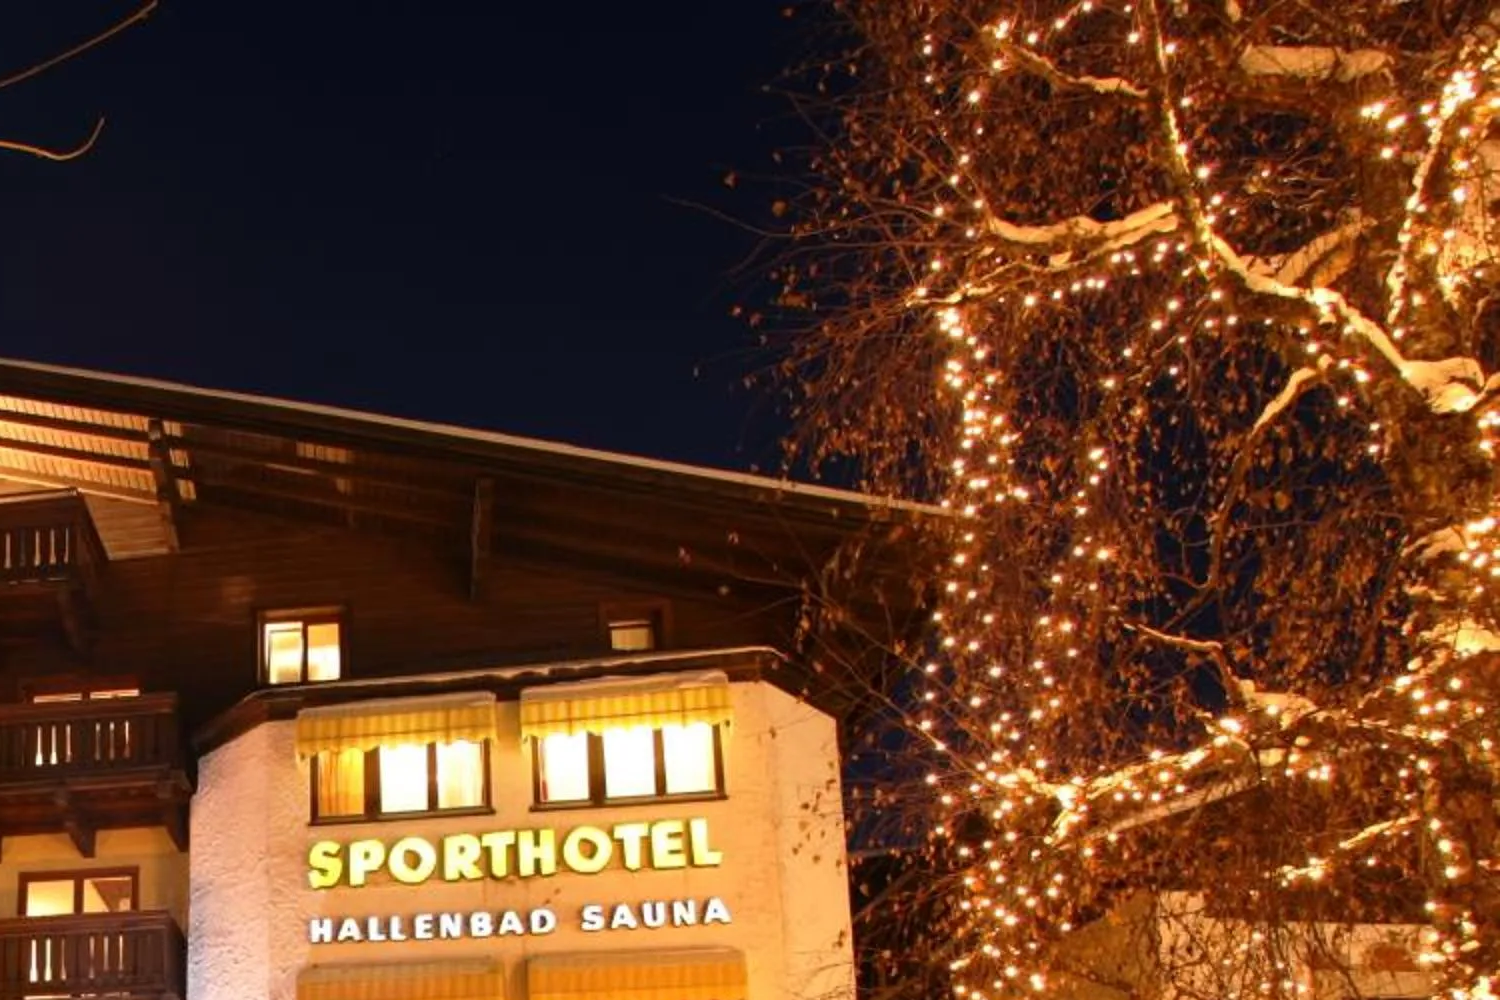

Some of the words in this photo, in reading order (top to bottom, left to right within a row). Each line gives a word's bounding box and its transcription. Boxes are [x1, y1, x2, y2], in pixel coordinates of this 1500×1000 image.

[309, 818, 722, 888] SPORTHOTEL
[309, 908, 557, 944] HALLENBAD
[581, 896, 731, 932] SAUNA
